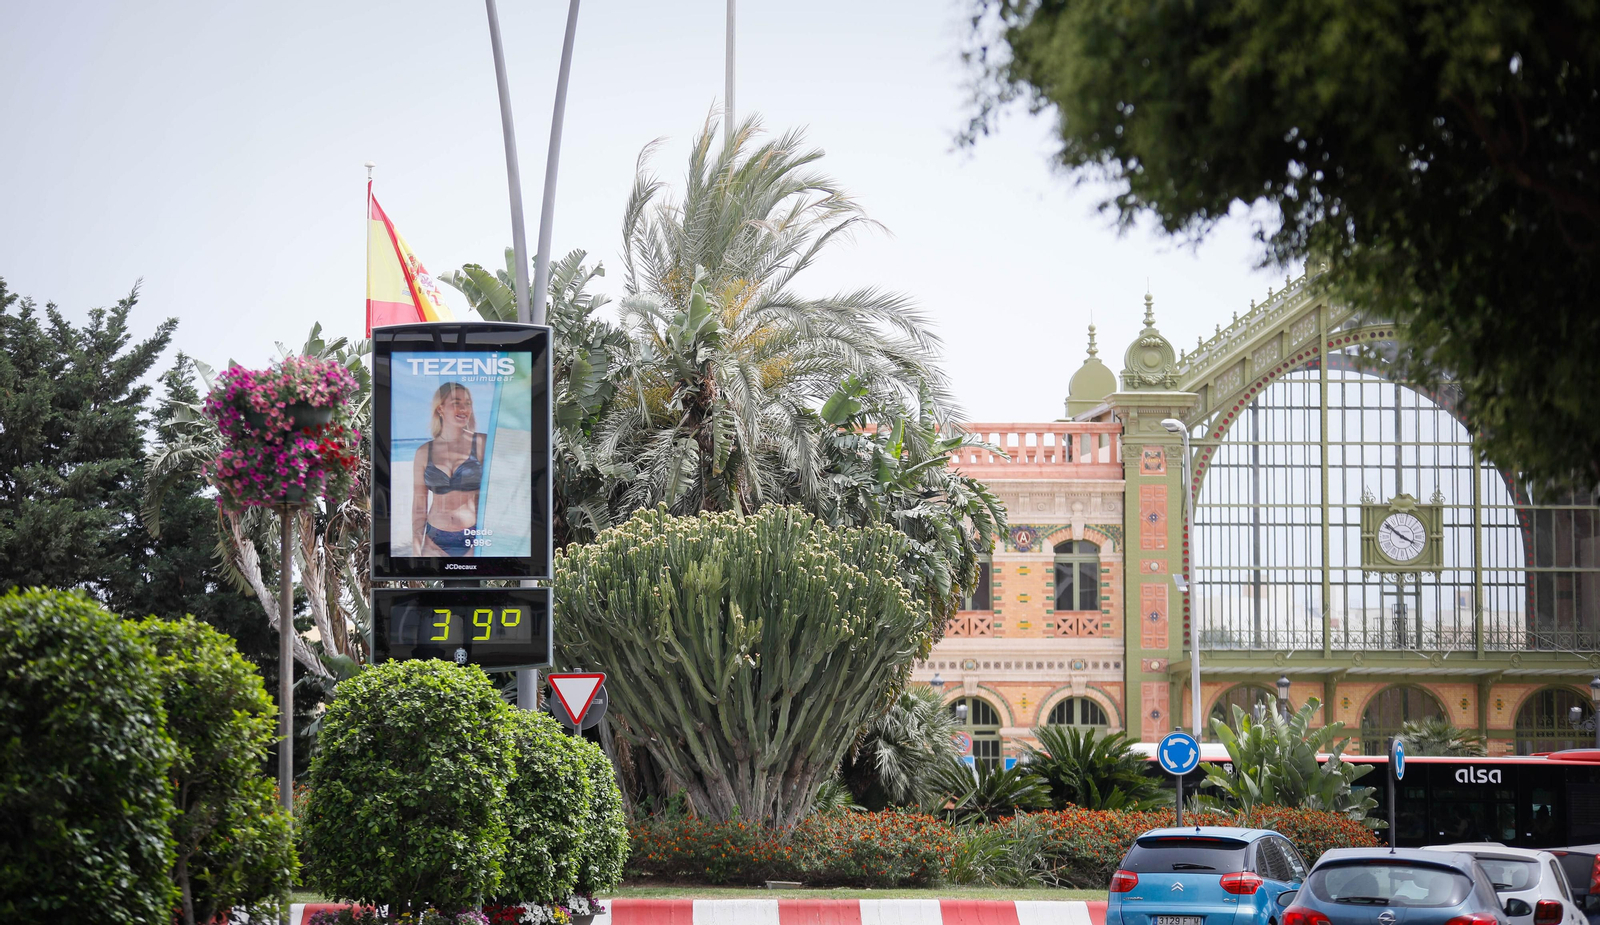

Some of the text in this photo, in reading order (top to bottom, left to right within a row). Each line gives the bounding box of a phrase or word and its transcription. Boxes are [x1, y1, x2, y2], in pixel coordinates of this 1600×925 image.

[465, 539, 492, 547] 9,99€
[1455, 765, 1502, 784] alsa
[1159, 917, 1180, 925] 3129
